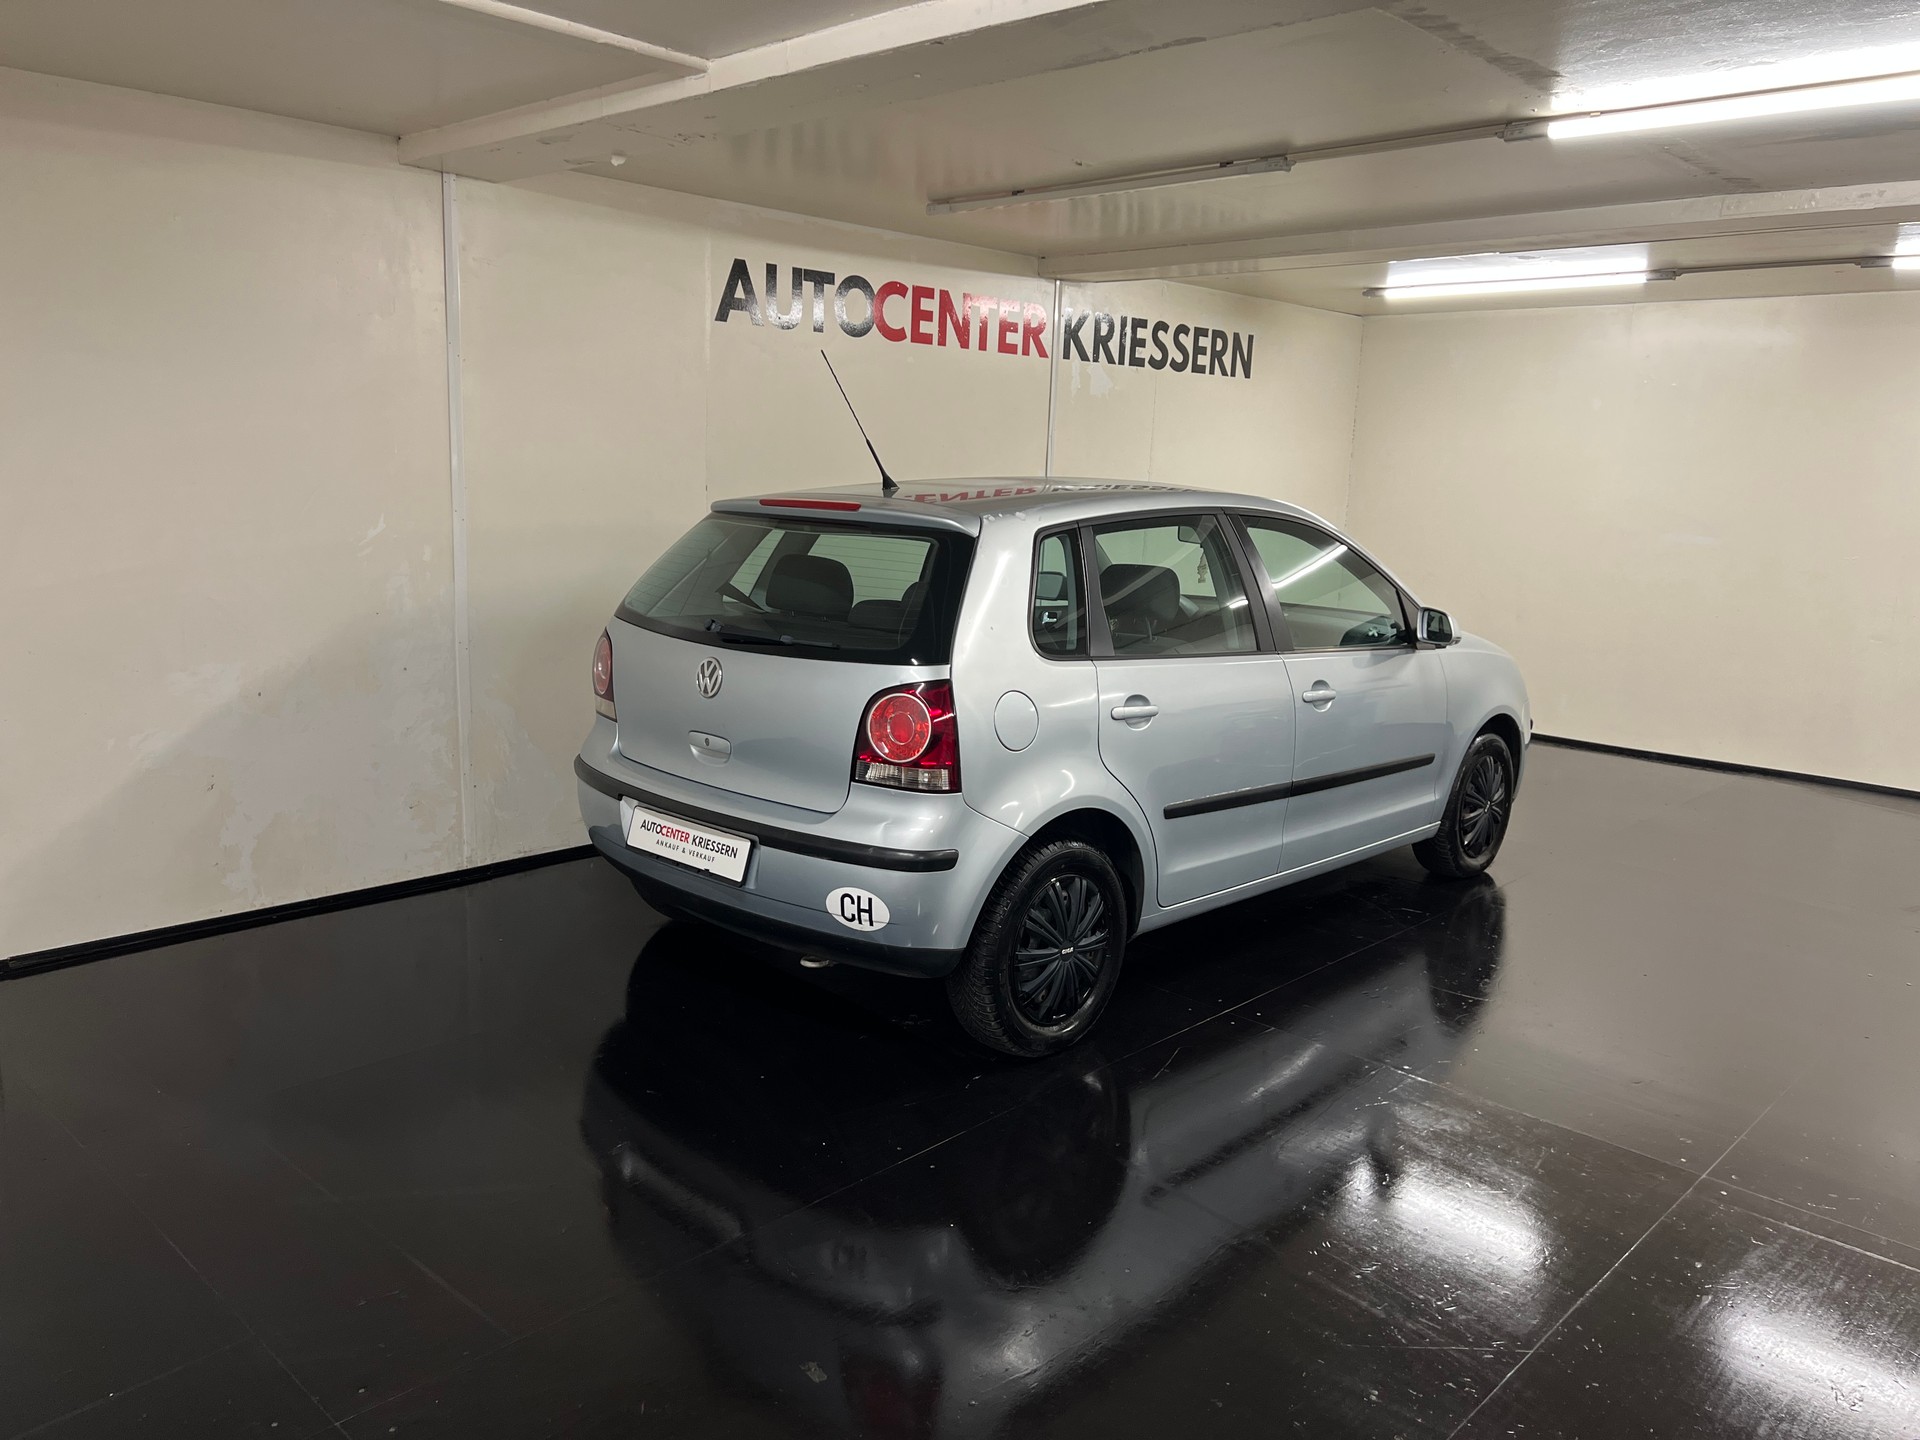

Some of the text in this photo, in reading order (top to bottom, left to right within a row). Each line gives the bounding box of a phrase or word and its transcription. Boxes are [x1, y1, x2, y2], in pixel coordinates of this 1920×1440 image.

[714, 257, 1255, 379] AUTOCENTER KRIESSERN
[698, 656, 723, 698] VW
[640, 819, 738, 859] AUTOCENTER KRIESSERN
[656, 839, 680, 852] ANKAUF
[688, 848, 716, 863] VERKAUF
[840, 892, 874, 927] CH
